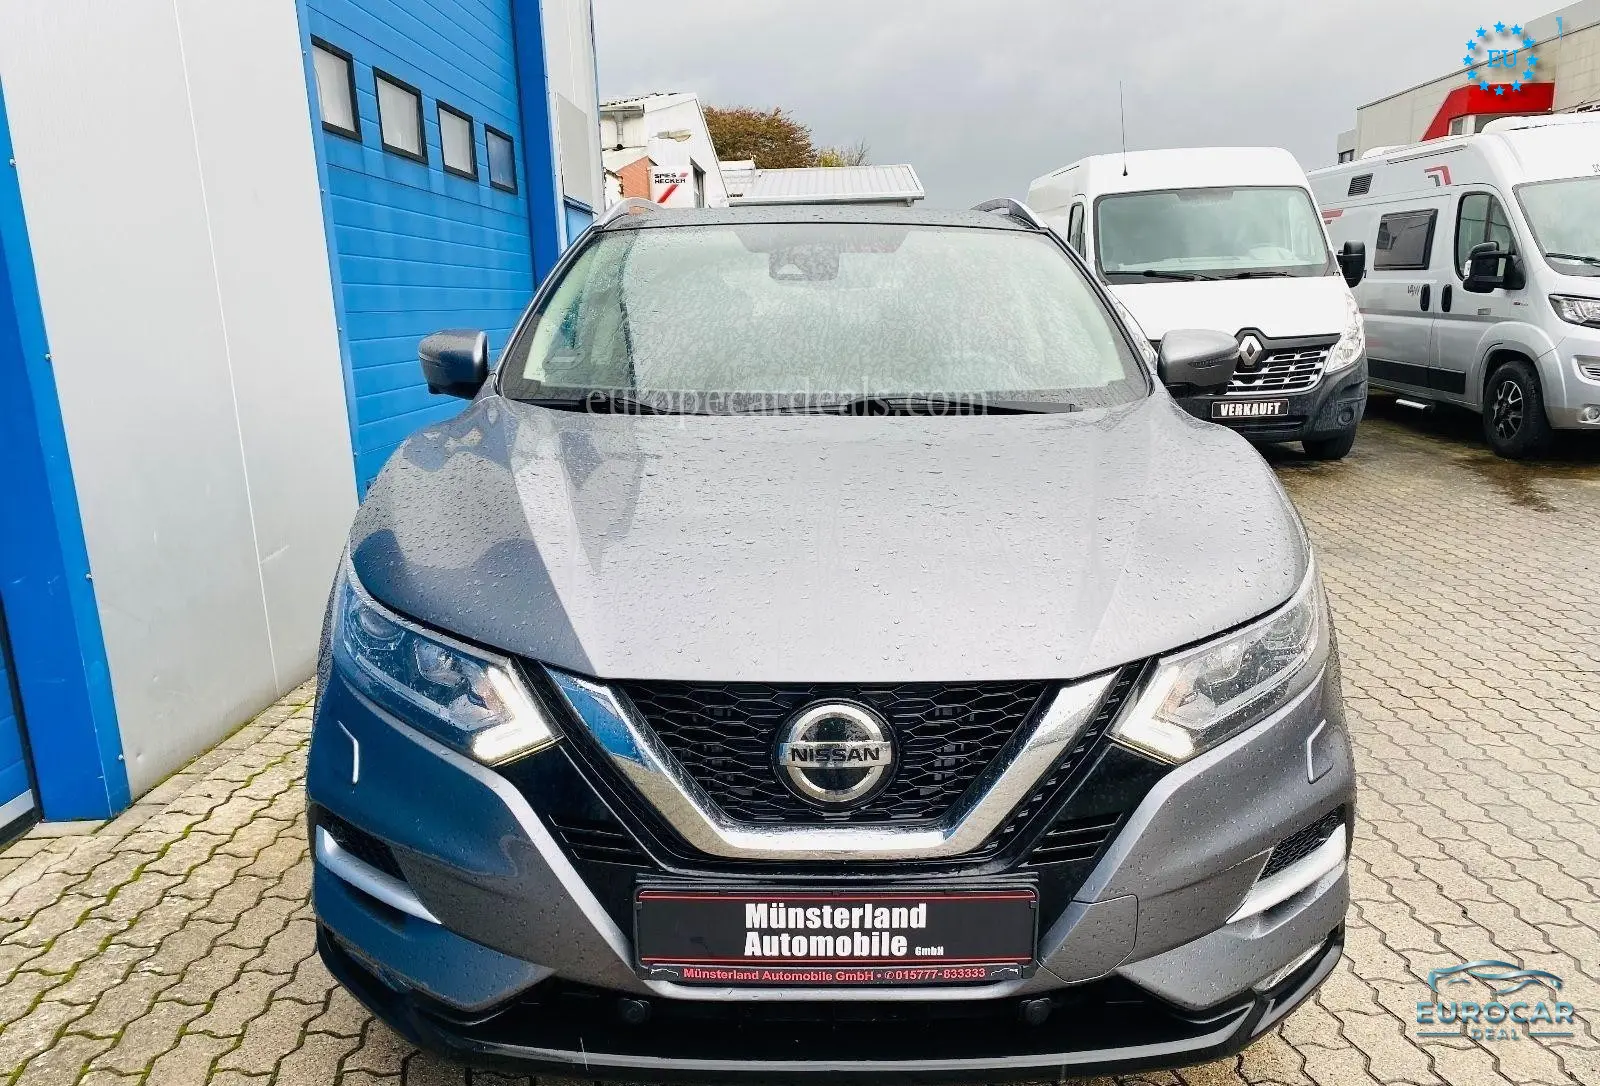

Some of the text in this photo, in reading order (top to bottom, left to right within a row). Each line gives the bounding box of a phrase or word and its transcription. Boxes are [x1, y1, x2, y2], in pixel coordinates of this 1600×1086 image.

[1220, 402, 1281, 417] VERKAUFT
[790, 747, 880, 762] NISSAN
[744, 902, 928, 930] Münsterland
[743, 931, 945, 958] Automobile GmbH
[683, 967, 760, 981] Münsterland
[761, 969, 834, 982] Automobile
[835, 970, 875, 982] GmbH
